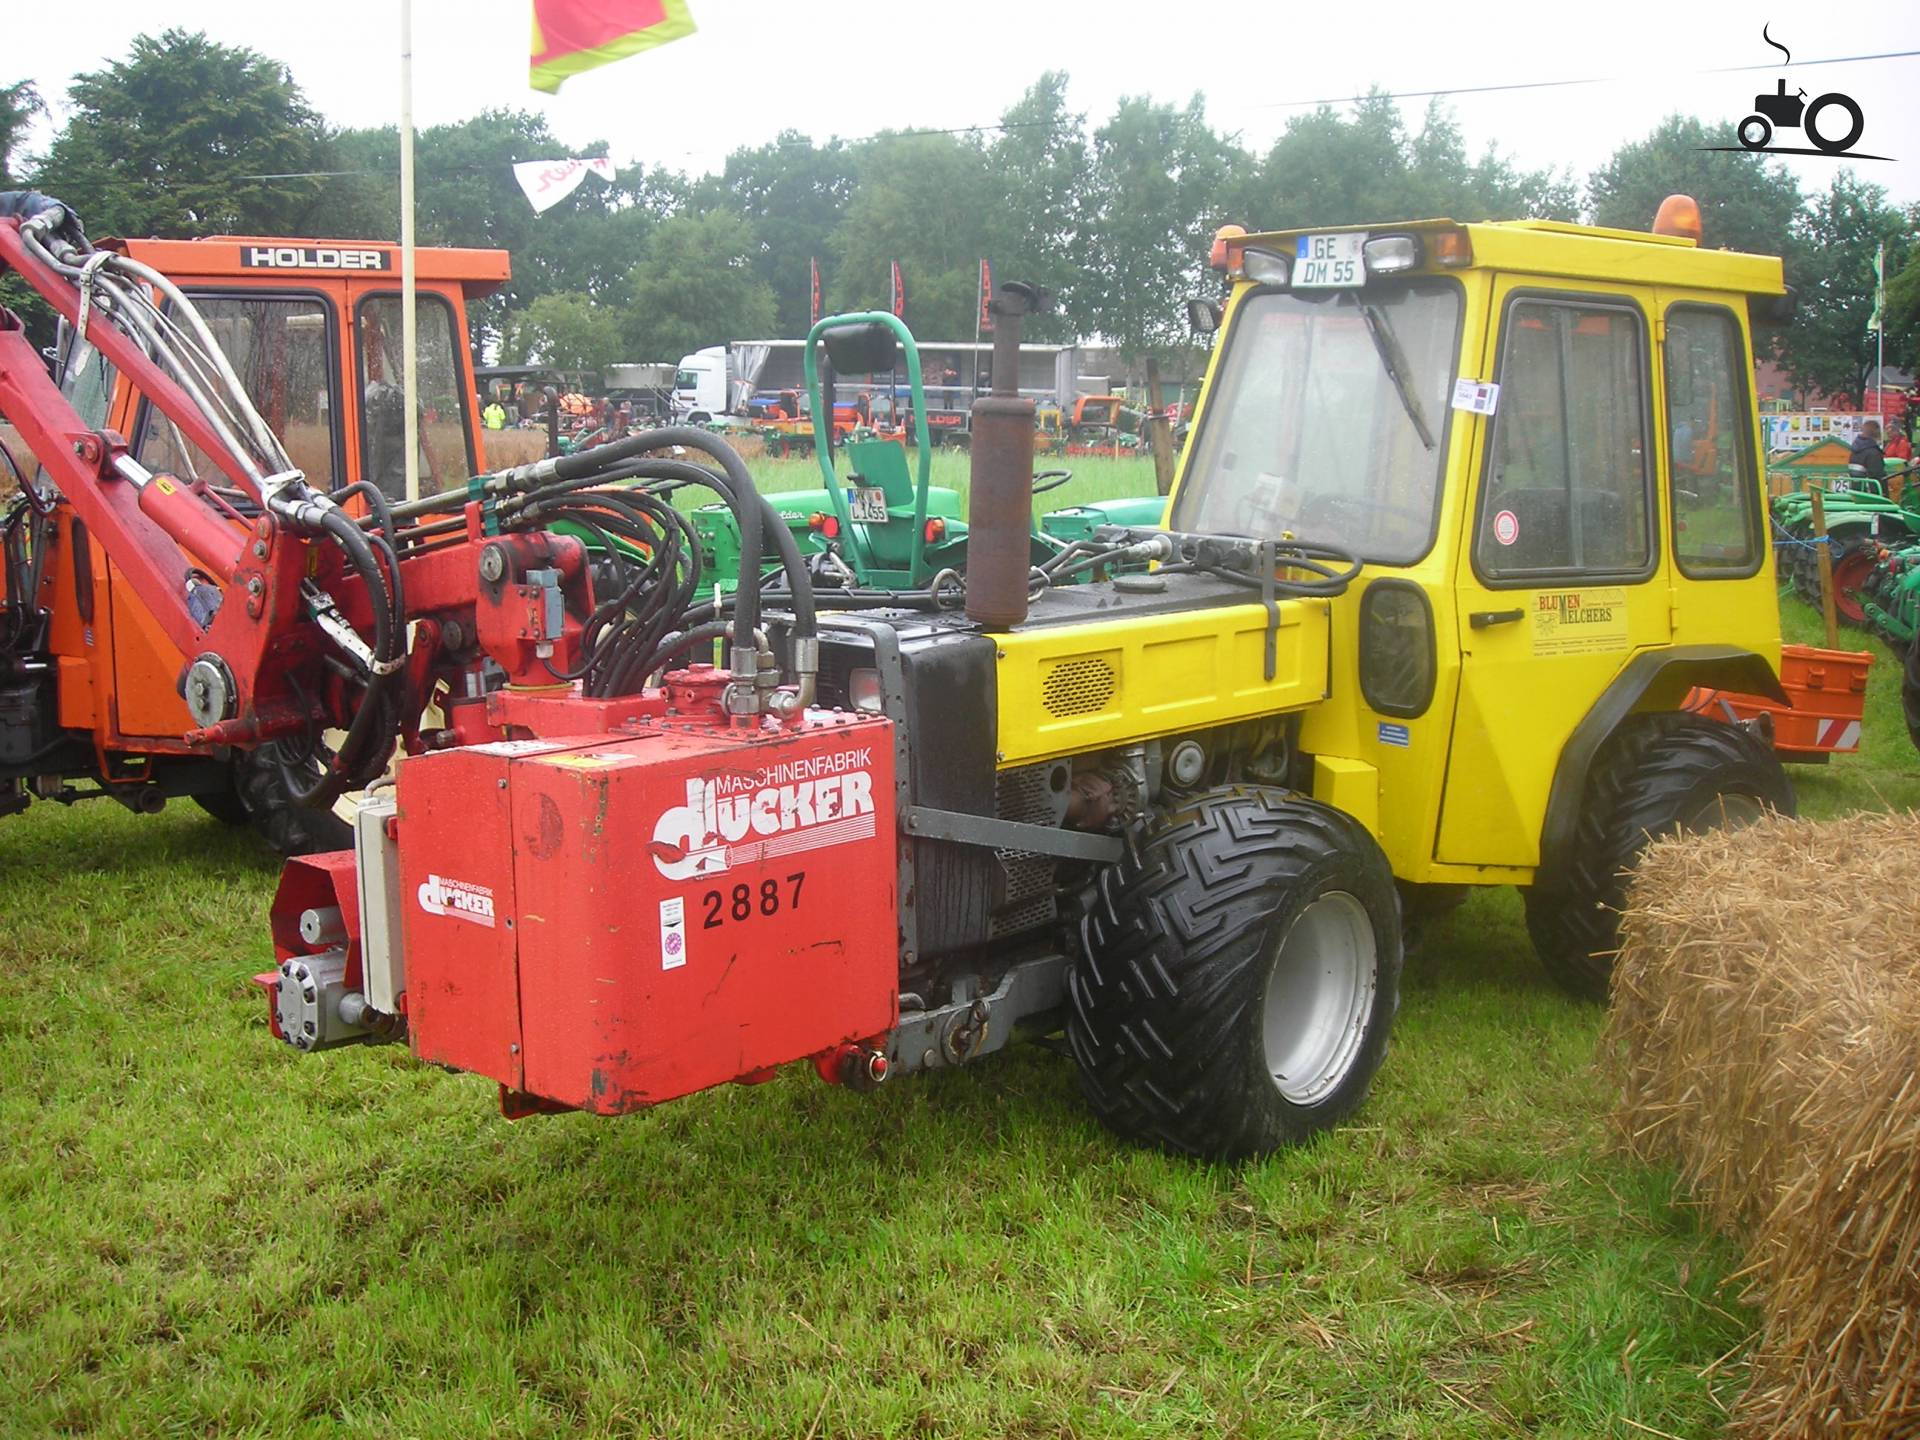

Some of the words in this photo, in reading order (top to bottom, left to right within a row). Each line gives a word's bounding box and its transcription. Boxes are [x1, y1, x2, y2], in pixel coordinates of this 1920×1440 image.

[250, 247, 382, 269] HOLDER
[1314, 237, 1337, 260] GE
[1303, 262, 1329, 283] DM
[1334, 260, 1355, 283] 55
[715, 747, 873, 796] MASCHINENFABRIK
[703, 871, 805, 930] 2887
